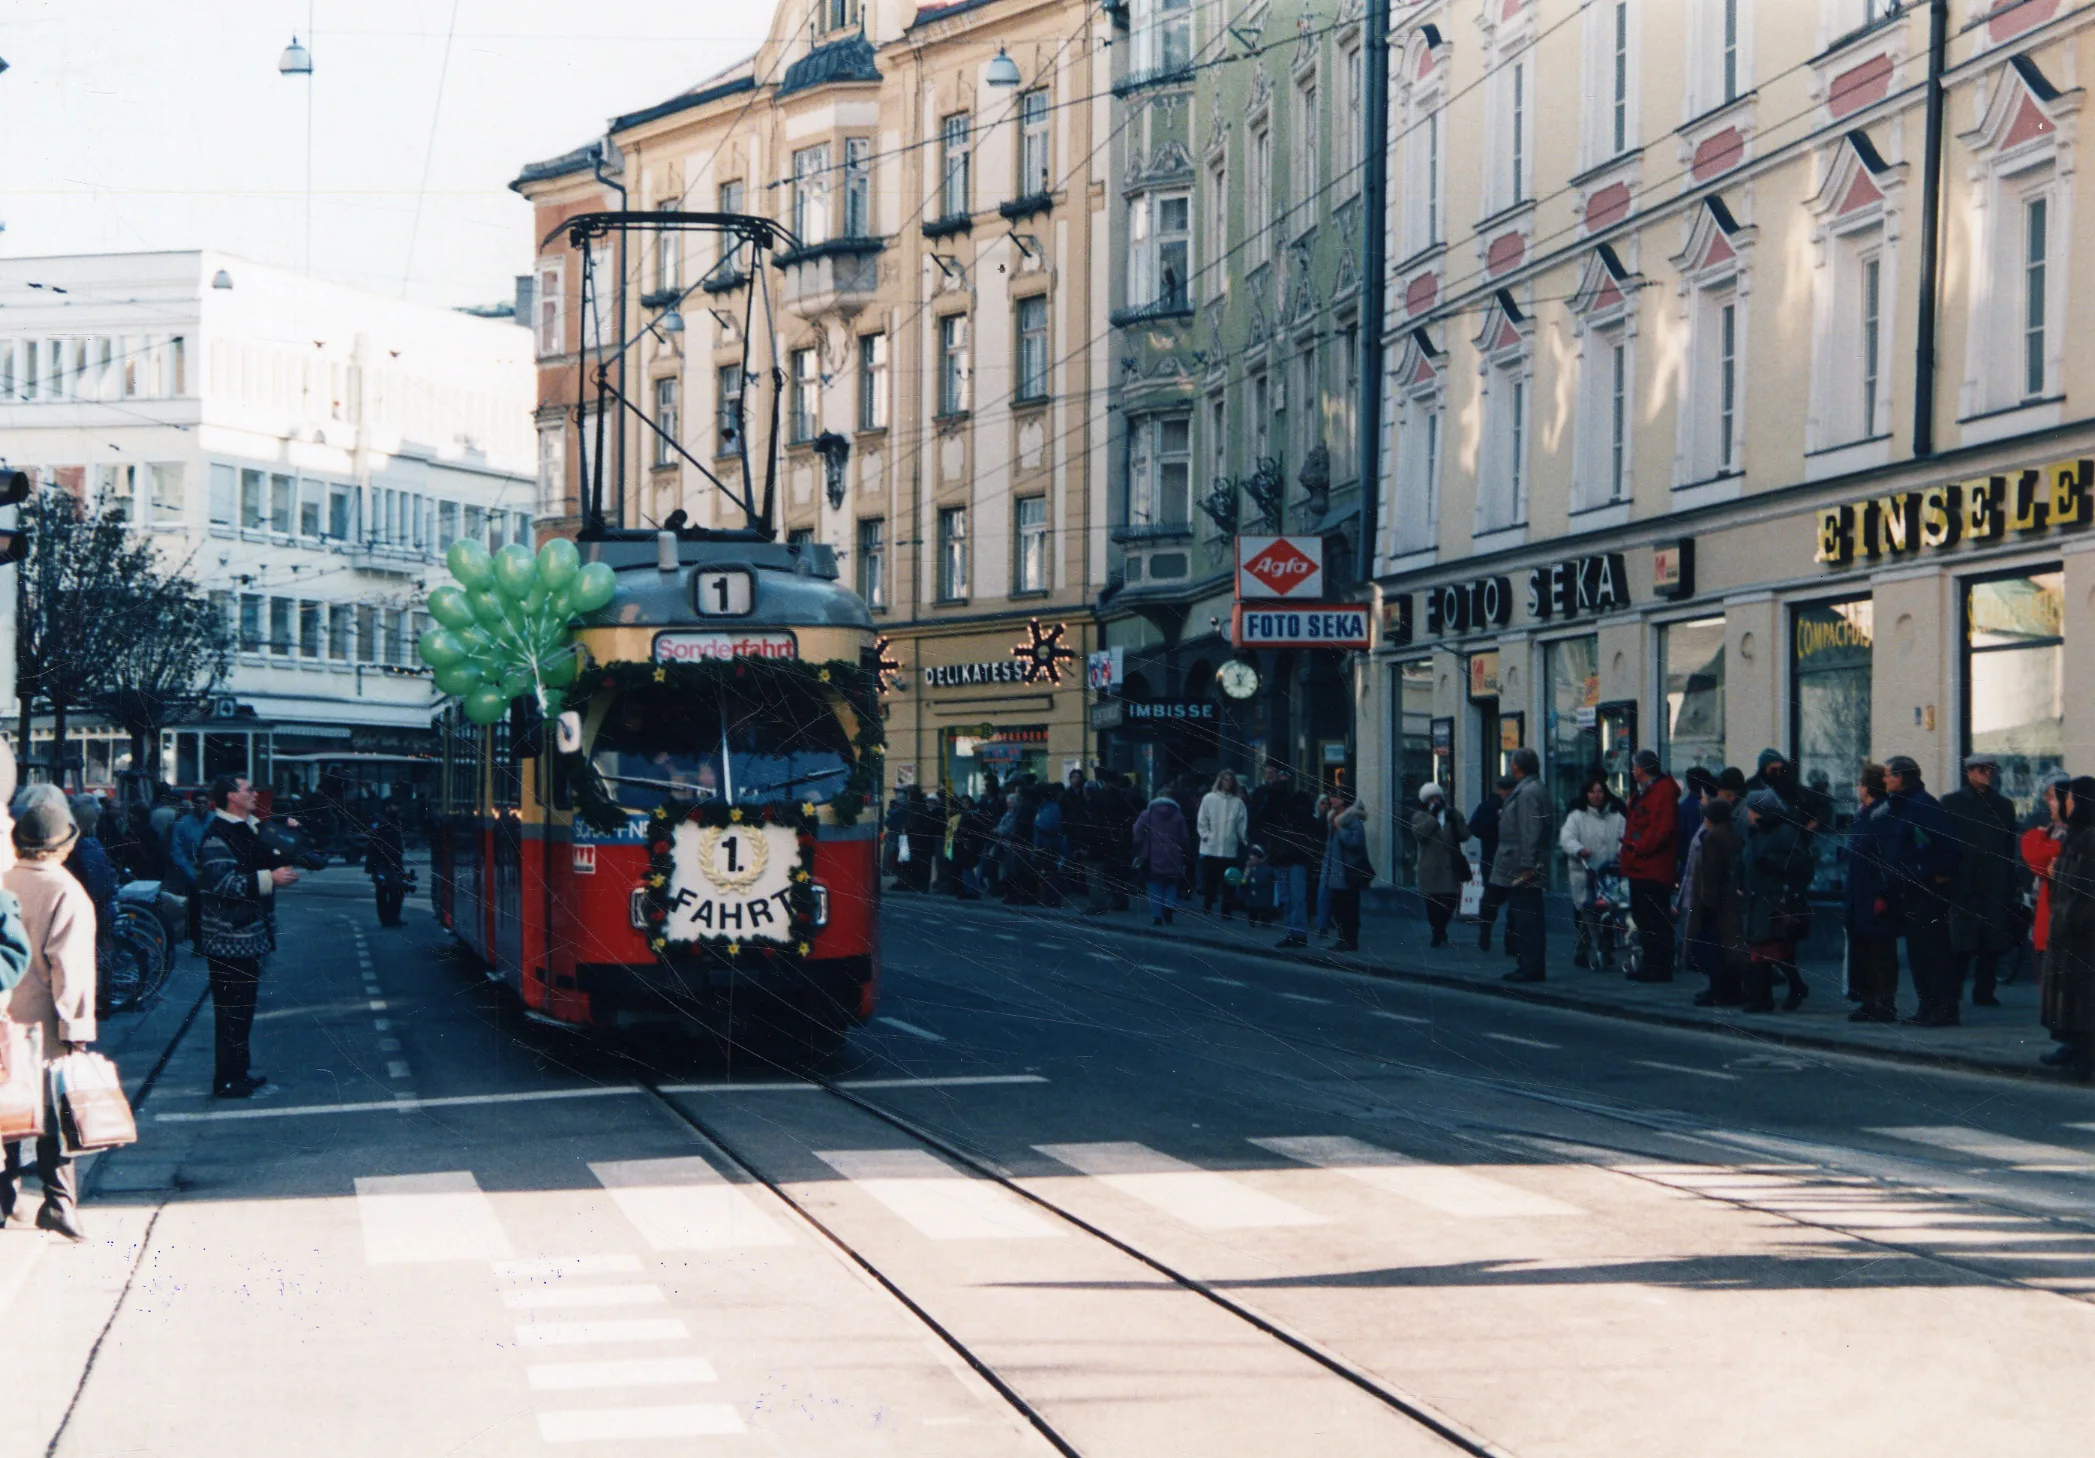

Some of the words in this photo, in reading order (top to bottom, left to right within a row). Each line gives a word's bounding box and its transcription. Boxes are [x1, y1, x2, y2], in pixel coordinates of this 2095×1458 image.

[1813, 460, 2080, 563] EINSELE
[1253, 556, 1309, 578] Agfa
[712, 577, 728, 612] 1
[1426, 577, 1500, 629] FOTO
[1526, 554, 1617, 617] SEKA
[1247, 613, 1300, 638] FOTO
[1307, 613, 1365, 638] SEKA
[657, 638, 793, 659] Sonderfahrt
[1128, 703, 1213, 718] IMBISSE
[721, 836, 745, 872] 1.
[670, 887, 798, 930] FAHRT
